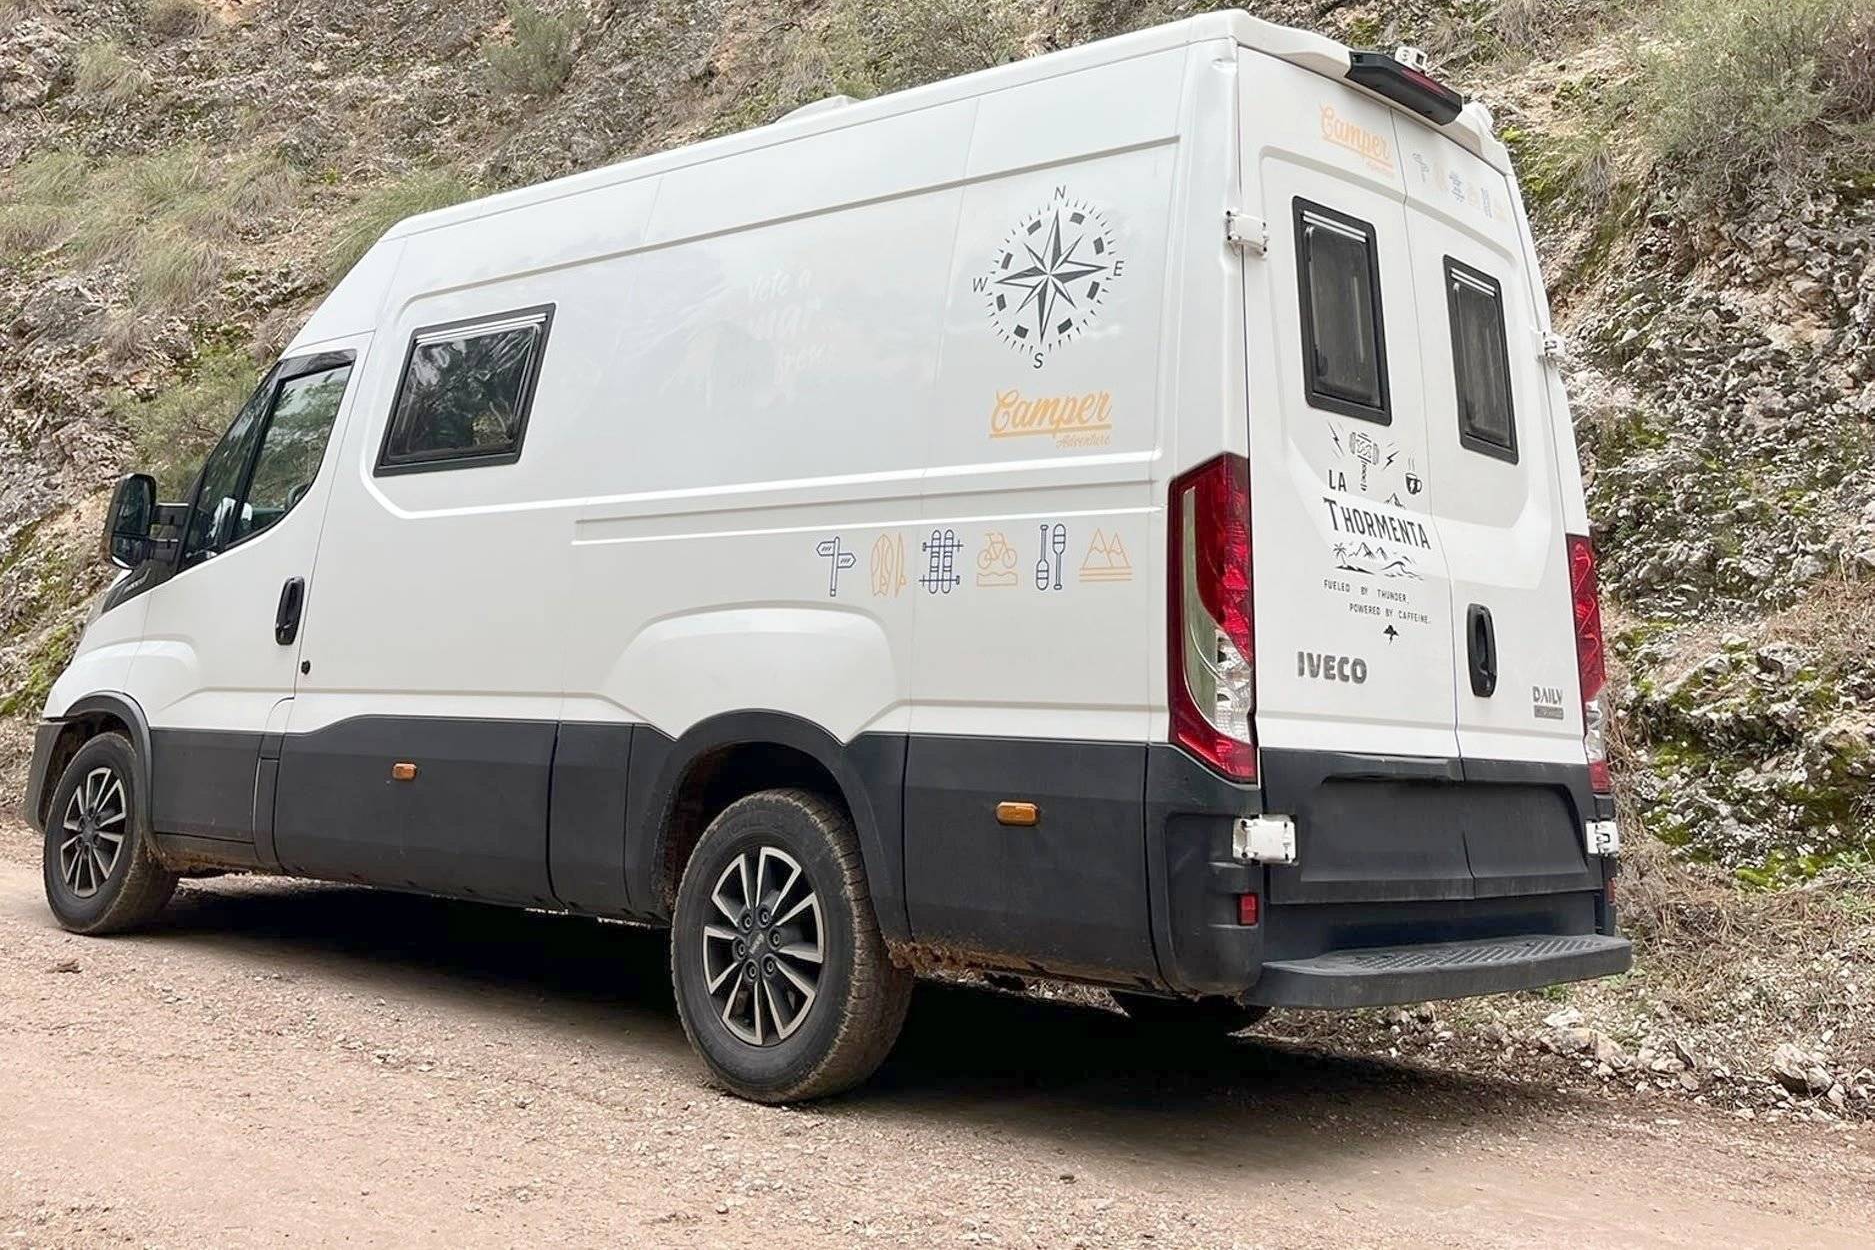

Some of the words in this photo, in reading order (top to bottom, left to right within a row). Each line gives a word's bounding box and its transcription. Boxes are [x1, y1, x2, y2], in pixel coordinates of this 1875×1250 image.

[1320, 104, 1393, 161] Camper
[1054, 184, 1067, 201] N
[1113, 261, 1125, 277] E
[972, 277, 988, 293] W
[1033, 352, 1044, 369] S
[991, 389, 1113, 438] Camper
[1328, 469, 1347, 492] LA
[1322, 496, 1431, 550] THORMENTA
[1324, 579, 1351, 593] FUELED
[1360, 586, 1368, 595] BY
[1349, 603, 1381, 616] POWERED
[1385, 608, 1394, 617] BY
[1297, 651, 1368, 685] IVECO
[1532, 685, 1563, 706] DAILY
